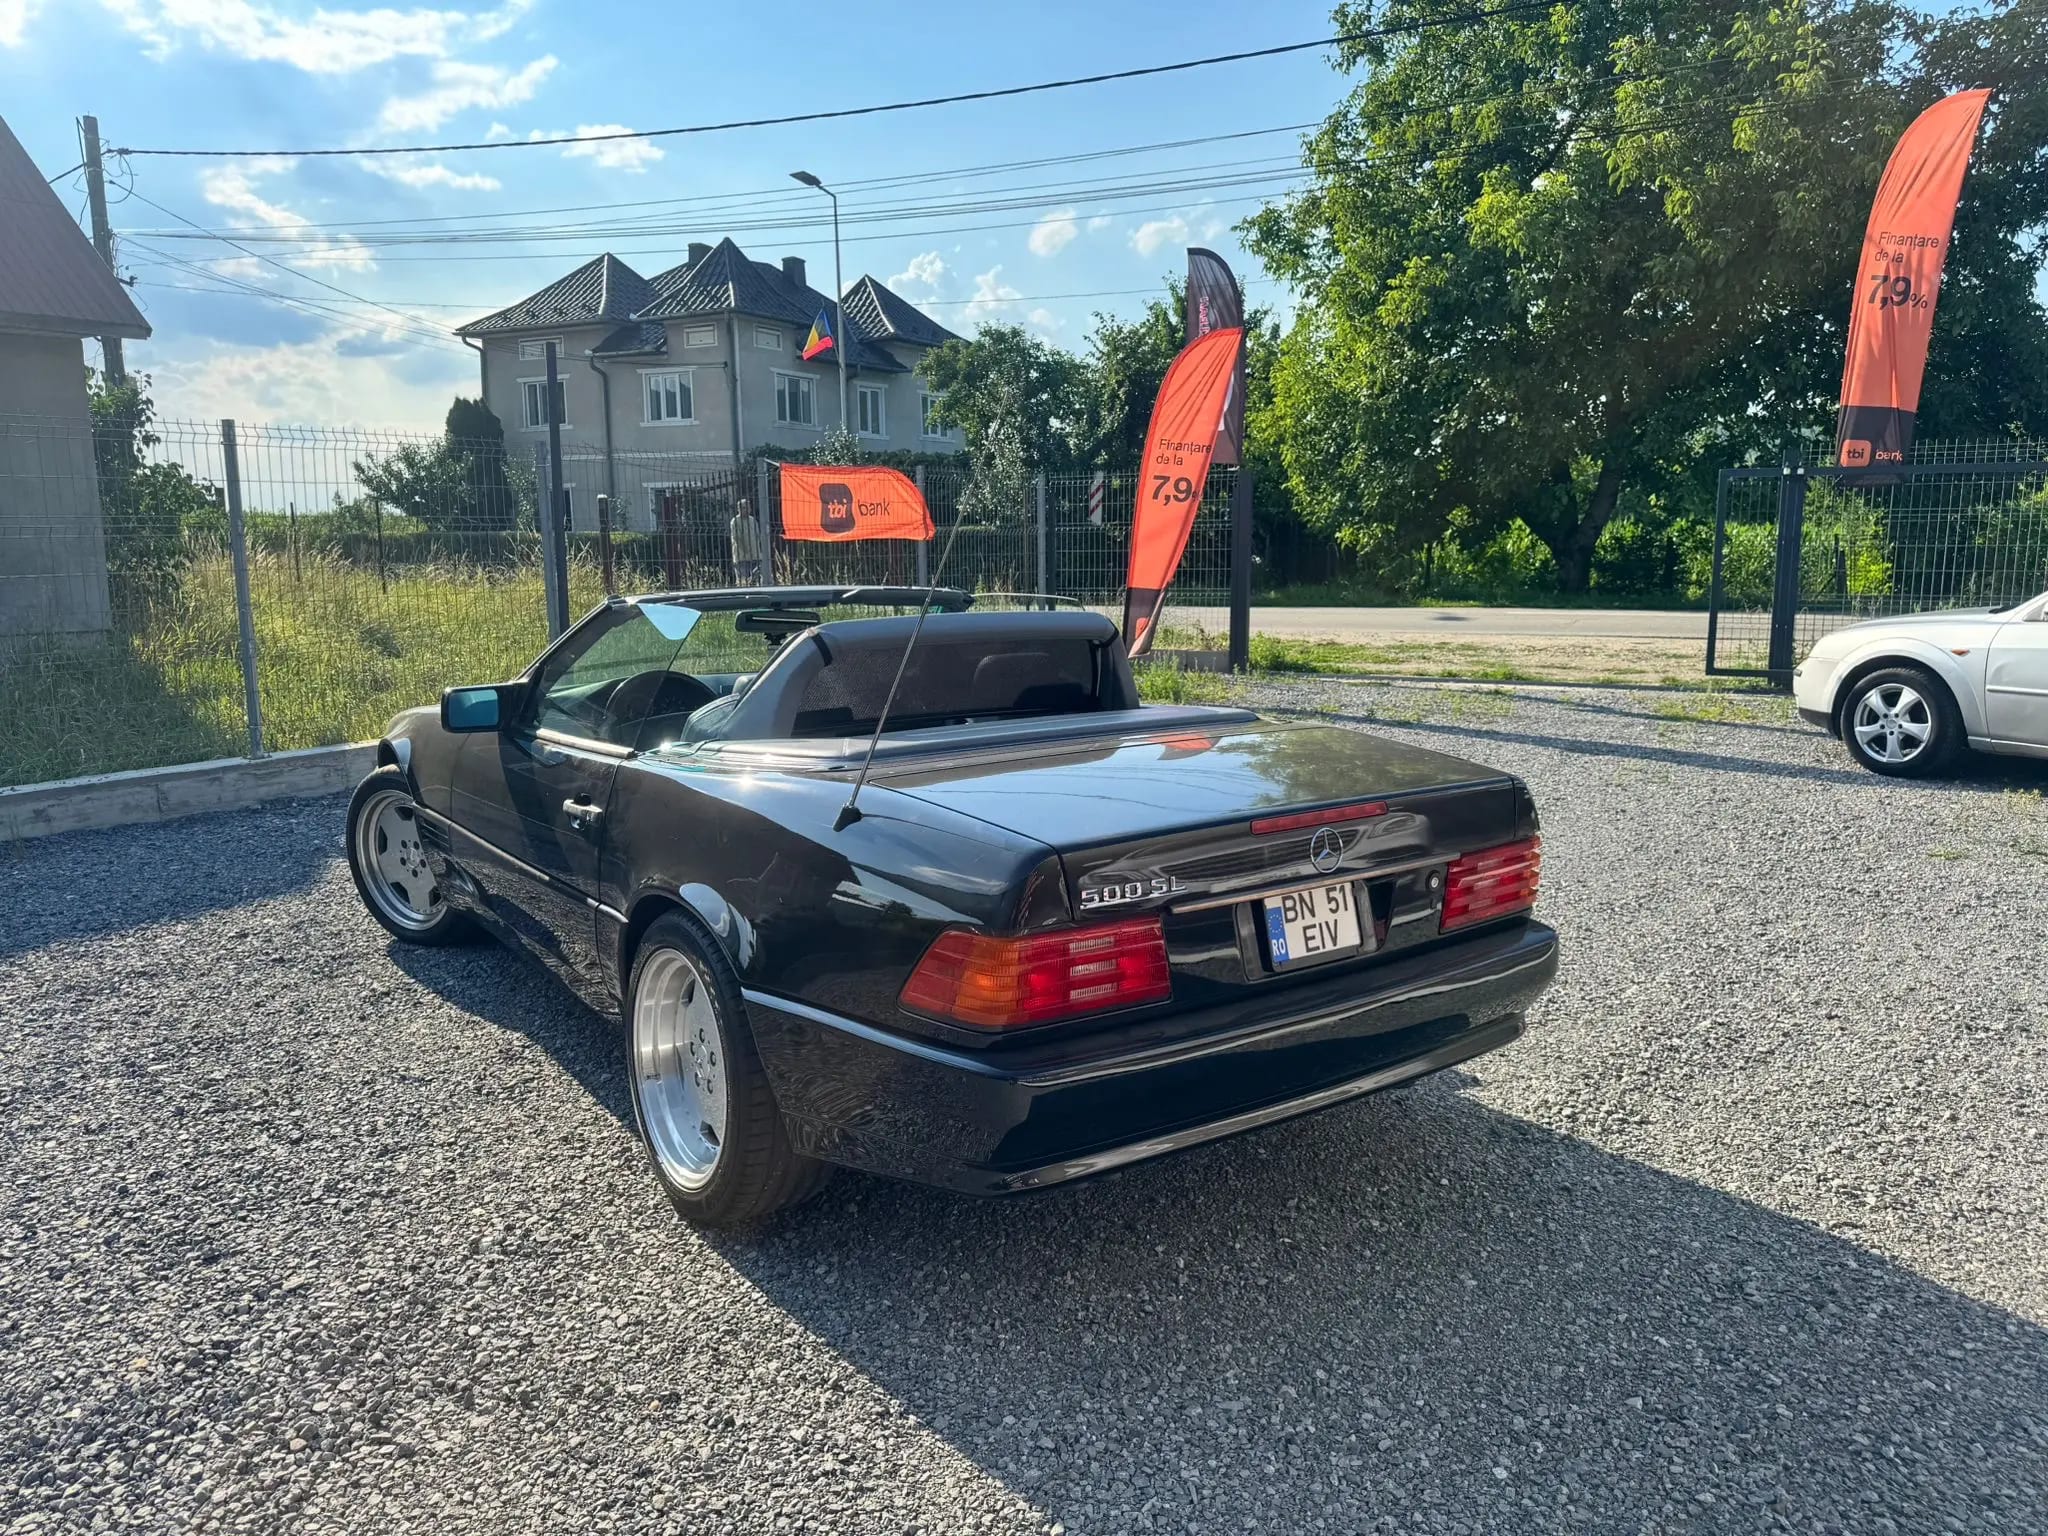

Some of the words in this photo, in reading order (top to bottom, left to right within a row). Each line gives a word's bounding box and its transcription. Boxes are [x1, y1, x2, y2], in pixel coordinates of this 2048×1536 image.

[1874, 248, 1889, 262] de
[1891, 249, 1904, 263] la
[1868, 274, 1928, 310] 7,9%
[1156, 453, 1170, 465] de
[1173, 453, 1184, 466] la
[1846, 447, 1865, 460] tbi
[827, 498, 848, 519] tbi
[857, 497, 891, 517] bank
[1081, 882, 1143, 905] 500
[1151, 876, 1187, 894] SL
[1281, 890, 1317, 924] BN
[1325, 884, 1349, 914] 51
[1302, 918, 1339, 953] EIV
[1271, 938, 1287, 957] RO
